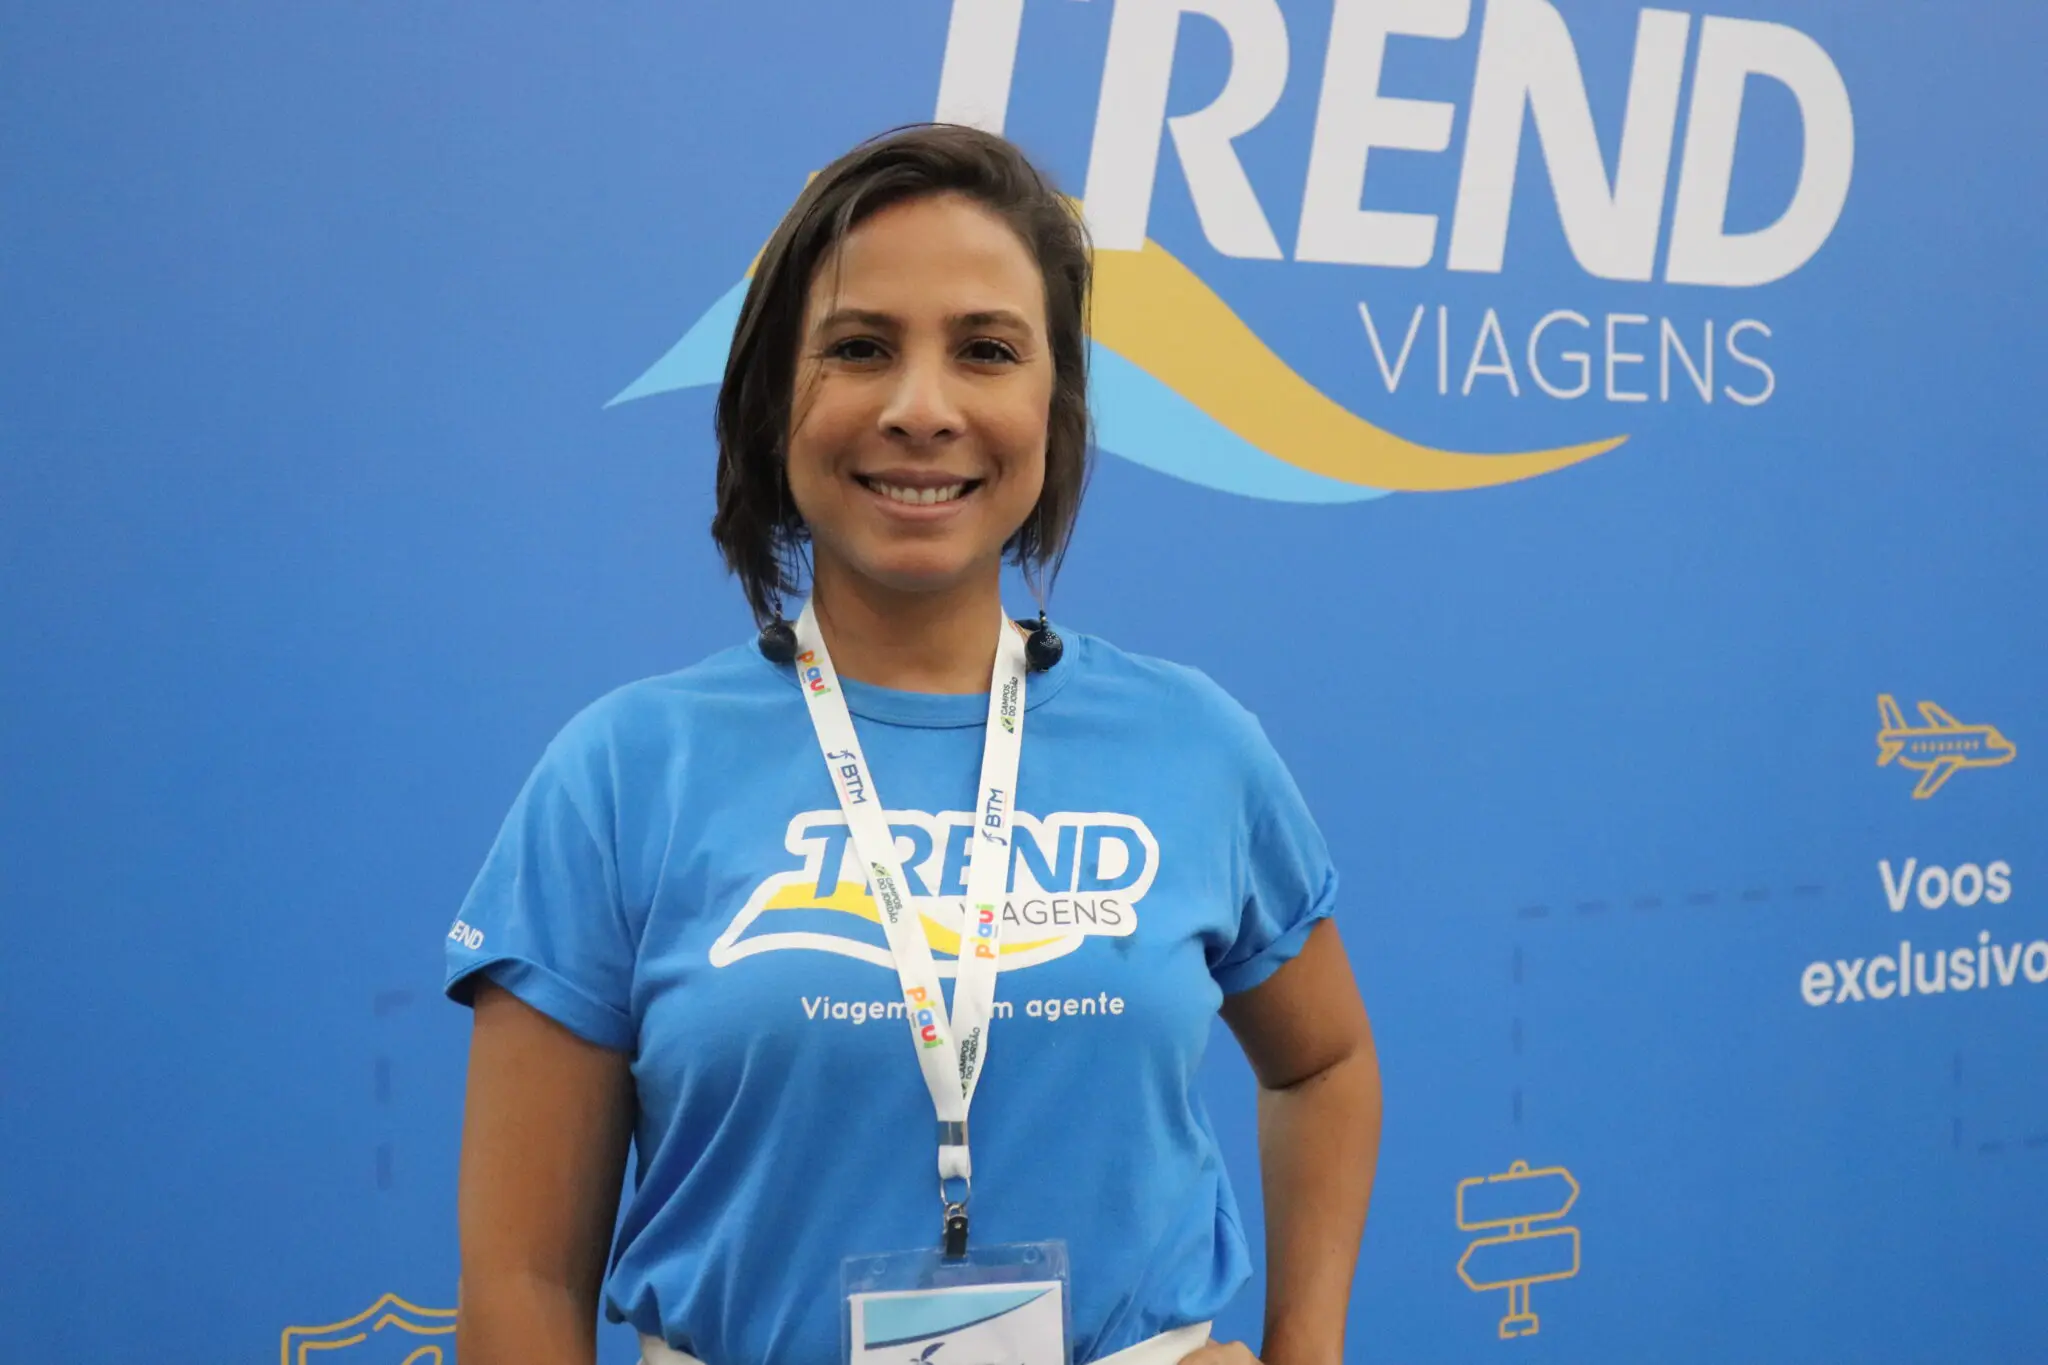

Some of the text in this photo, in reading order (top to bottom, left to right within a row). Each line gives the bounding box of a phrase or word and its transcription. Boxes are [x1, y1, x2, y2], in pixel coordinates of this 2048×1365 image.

[1358, 301, 1776, 406] VIAGENS
[840, 764, 867, 804] BTM
[985, 788, 1003, 828] BTM
[1878, 857, 2012, 912] Voos
[959, 900, 1121, 926] AGENS
[1026, 991, 1125, 1022] agente
